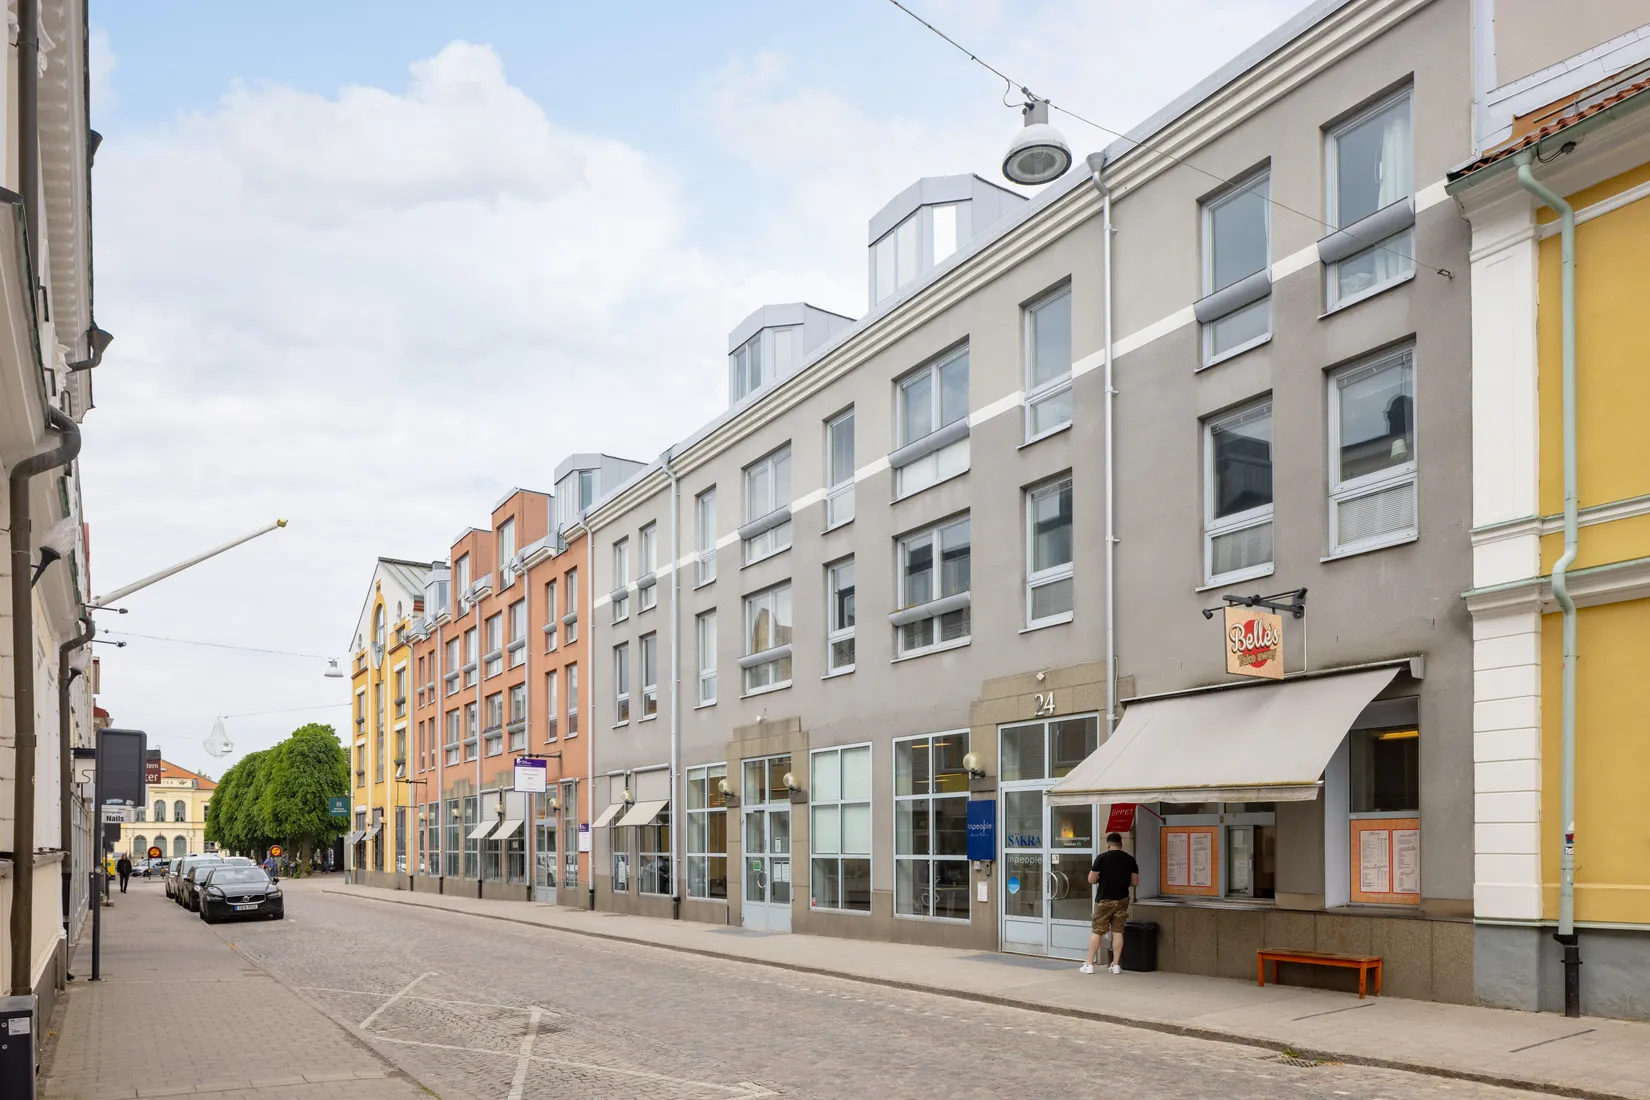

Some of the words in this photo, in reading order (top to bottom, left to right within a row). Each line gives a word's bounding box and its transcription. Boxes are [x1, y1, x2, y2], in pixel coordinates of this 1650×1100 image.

[1229, 619, 1280, 654] Belle's
[1034, 691, 1056, 716] 24
[1007, 832, 1043, 847] SÄKRA
